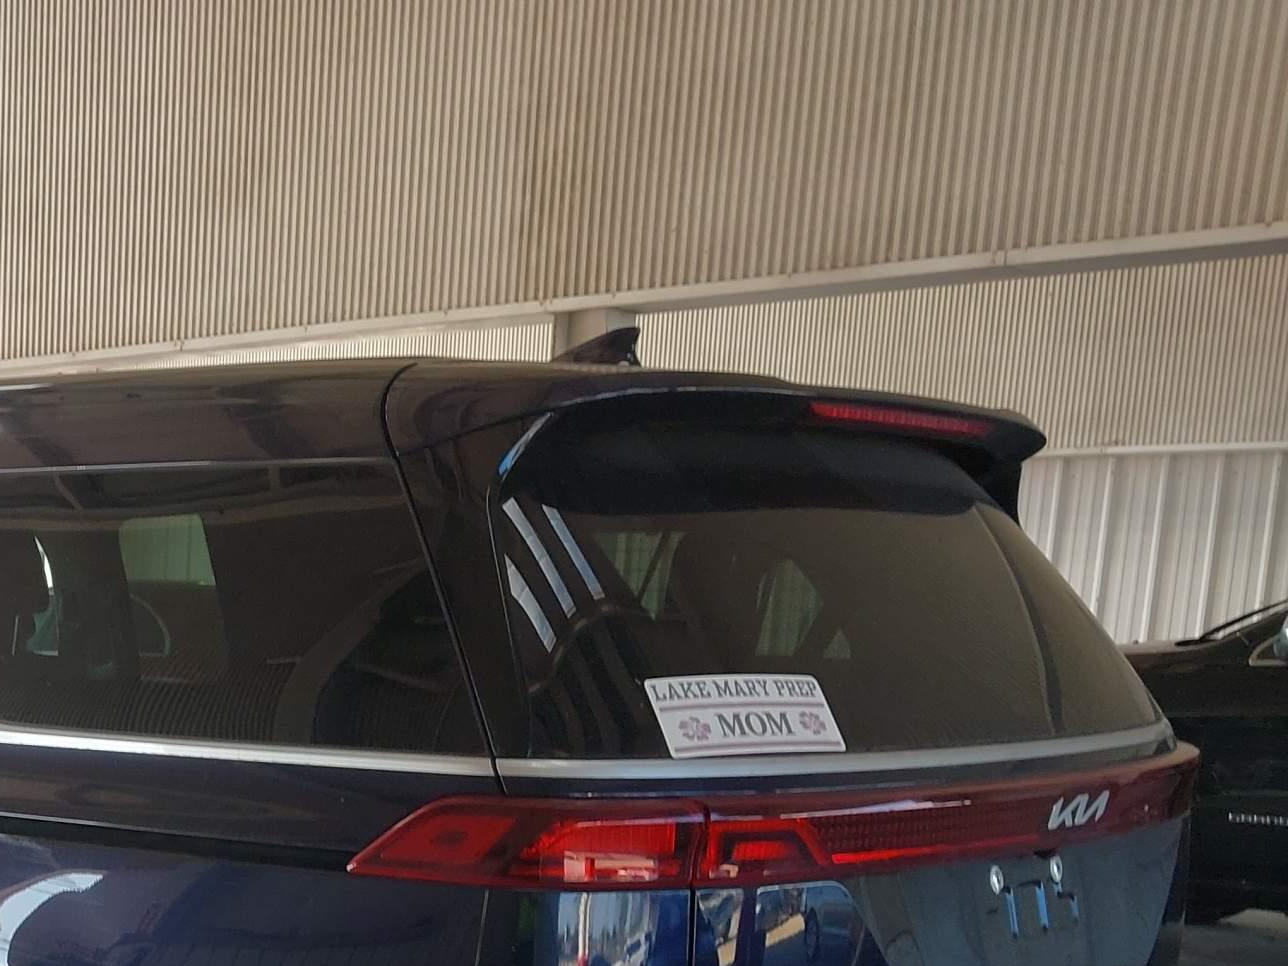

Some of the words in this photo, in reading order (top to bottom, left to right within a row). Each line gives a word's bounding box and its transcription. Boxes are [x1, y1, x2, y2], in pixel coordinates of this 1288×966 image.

[650, 680, 712, 703] LAKE
[712, 678, 771, 698] MARY
[772, 679, 818, 698] PREP
[714, 710, 797, 738] MOM
[1047, 789, 1110, 831] KIA
